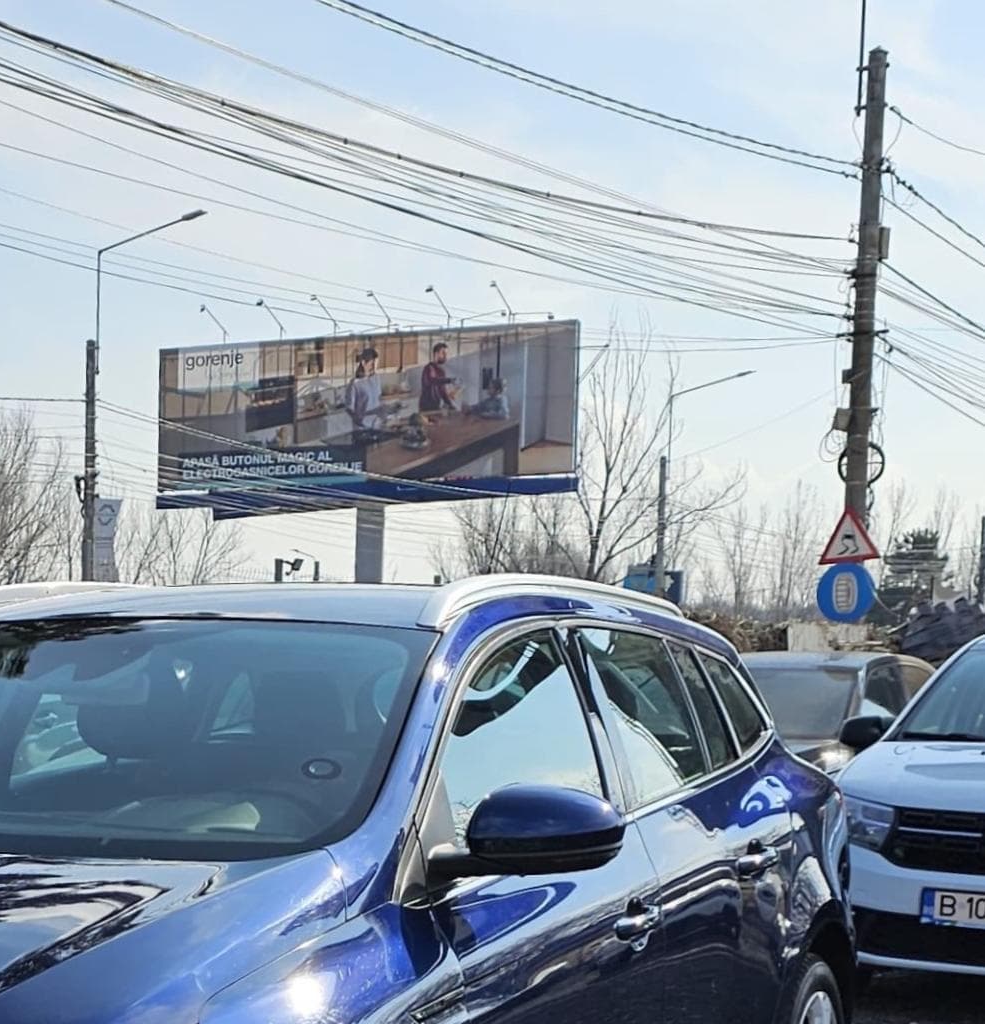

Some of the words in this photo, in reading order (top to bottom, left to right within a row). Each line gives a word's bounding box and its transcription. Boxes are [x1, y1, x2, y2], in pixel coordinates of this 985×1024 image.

[185, 350, 244, 371] gorenje
[222, 453, 275, 466] BUTONUL
[278, 451, 315, 463] MAGIC
[317, 450, 333, 461] AL
[939, 894, 957, 917] B
